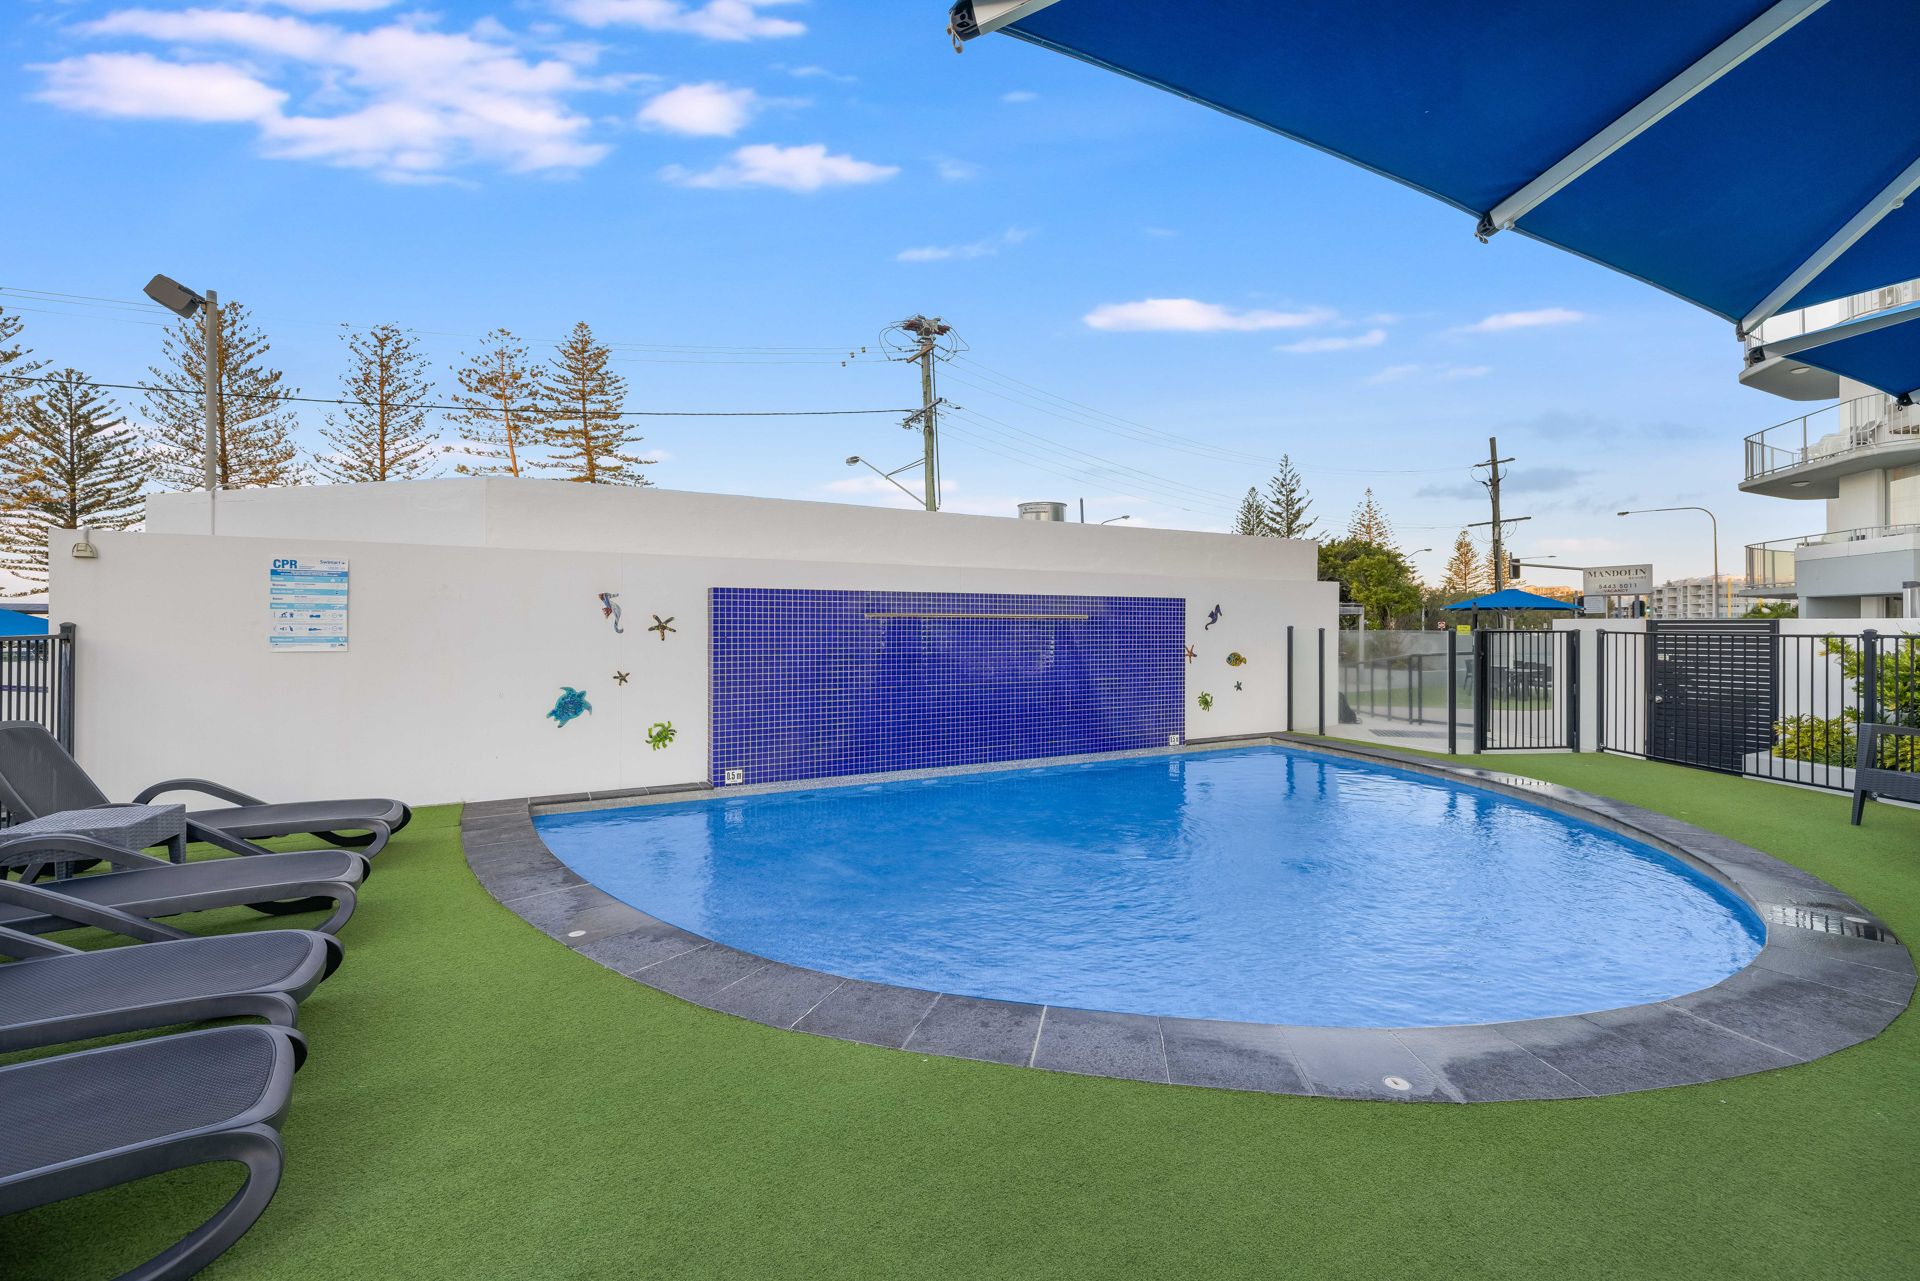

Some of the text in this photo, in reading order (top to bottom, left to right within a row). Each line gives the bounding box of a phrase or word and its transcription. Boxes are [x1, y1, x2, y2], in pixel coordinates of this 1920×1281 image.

[273, 559, 298, 569] CPR
[1588, 568, 1647, 578] MANDOLIN
[727, 772, 735, 780] 0.5
